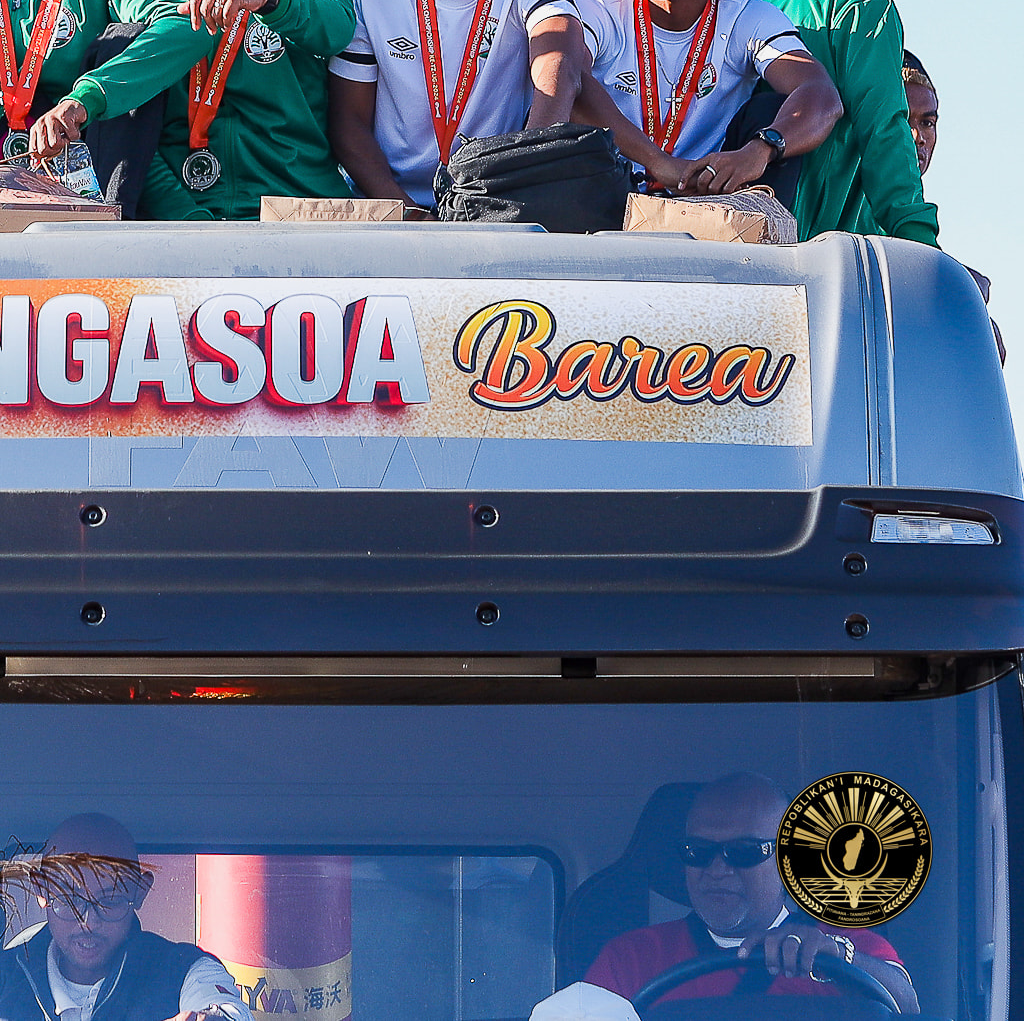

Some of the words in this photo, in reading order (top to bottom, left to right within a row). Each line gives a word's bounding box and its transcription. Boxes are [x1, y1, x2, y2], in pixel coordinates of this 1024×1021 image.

[389, 50, 415, 60] umbro
[469, 14, 486, 58] CHAMPIONSHIP
[642, 43, 652, 88] CHAMPIONSHIP
[681, 51, 700, 94] CHAMPIONSHIP
[614, 83, 637, 96] umbr
[453, 299, 796, 411] Barea
[303, 979, 342, 1012] 海沃
